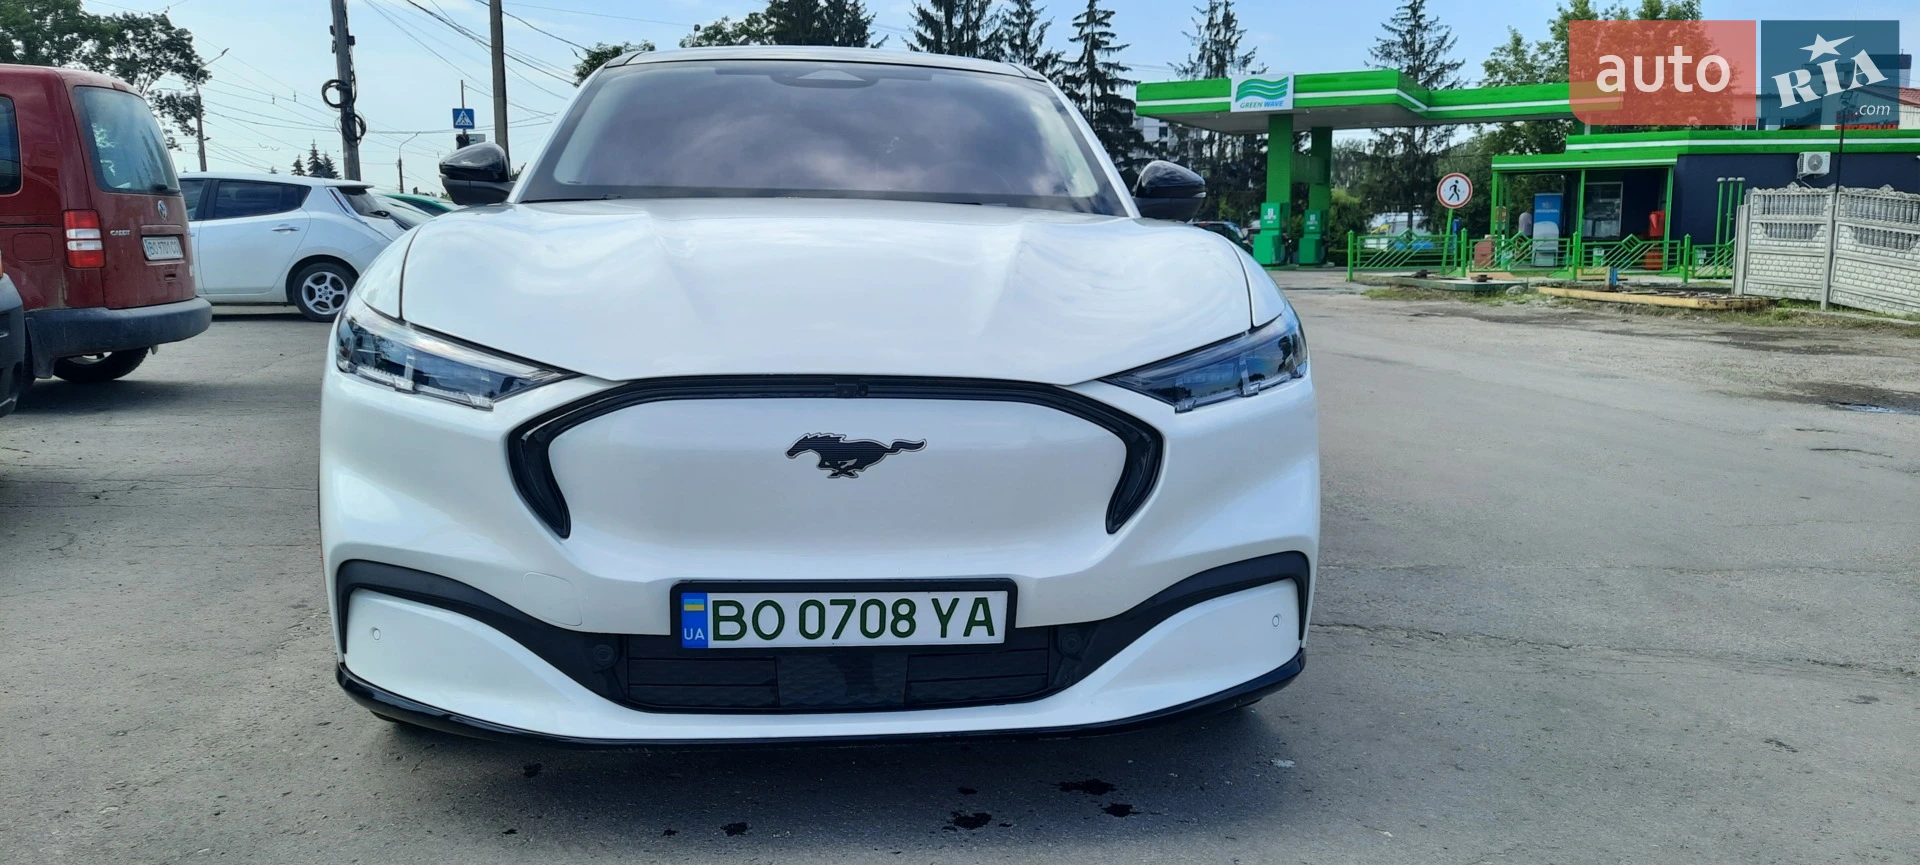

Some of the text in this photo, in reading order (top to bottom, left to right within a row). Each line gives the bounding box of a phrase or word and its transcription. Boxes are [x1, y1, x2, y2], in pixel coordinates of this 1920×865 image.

[1240, 101, 1263, 109] GREEN
[712, 597, 996, 641] BO 0708 YA
[683, 628, 705, 641] UA
